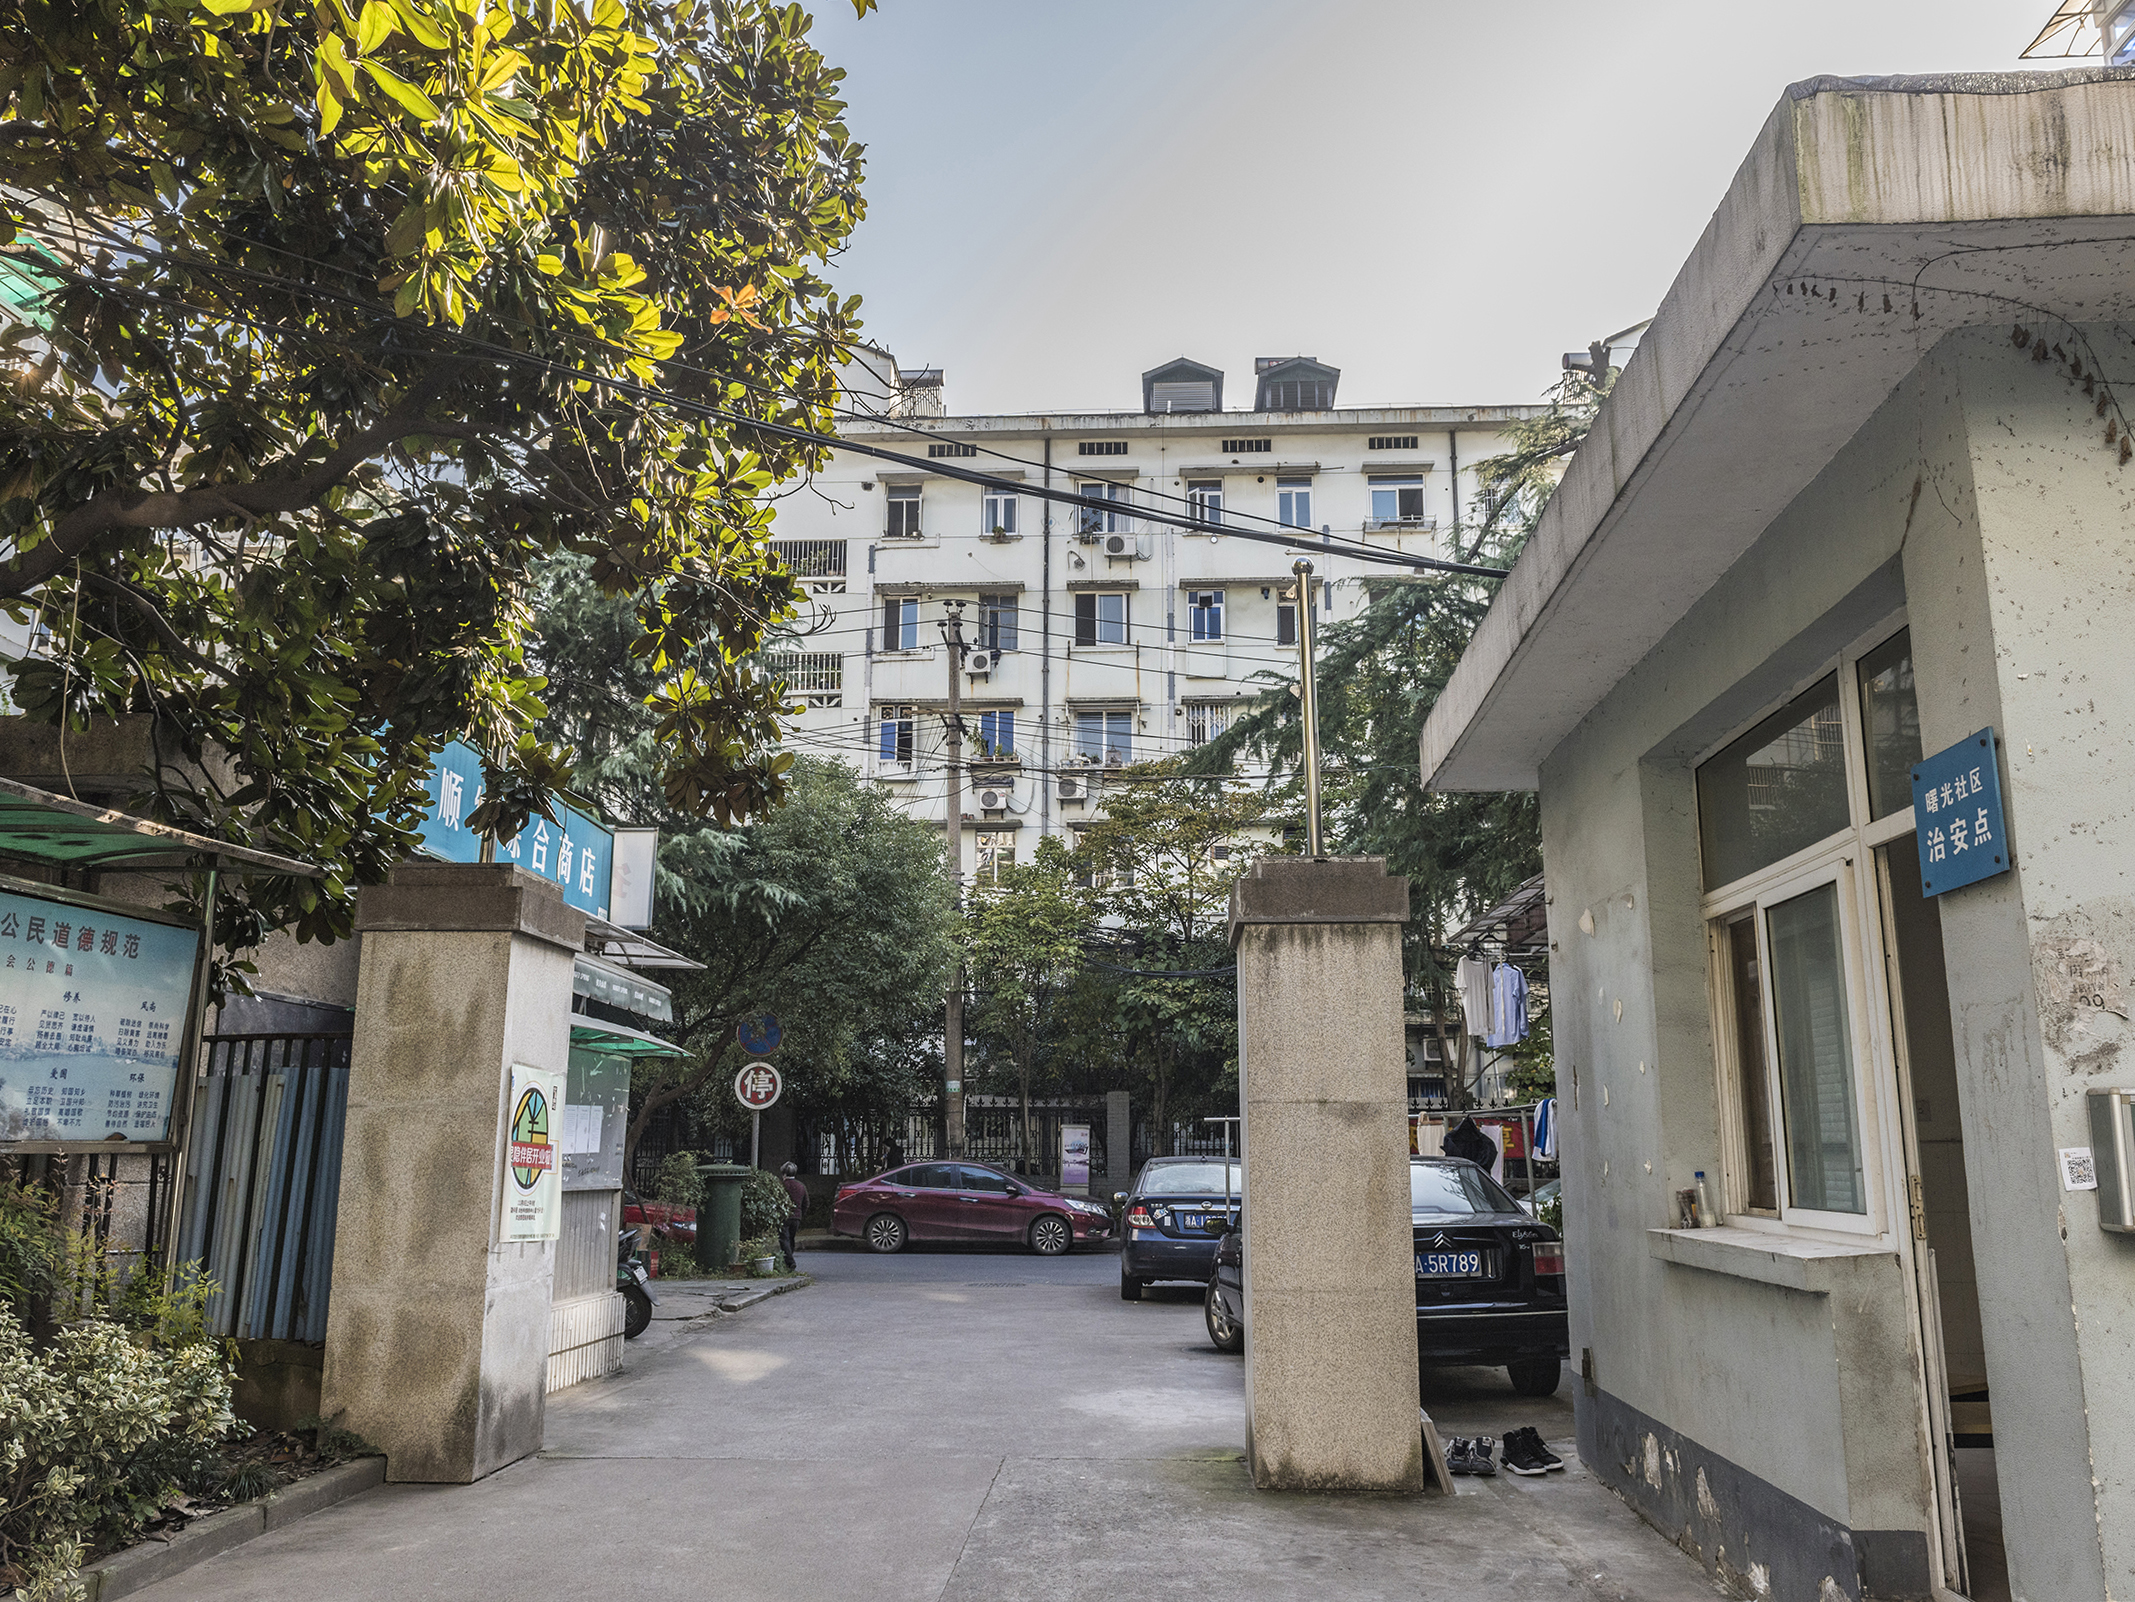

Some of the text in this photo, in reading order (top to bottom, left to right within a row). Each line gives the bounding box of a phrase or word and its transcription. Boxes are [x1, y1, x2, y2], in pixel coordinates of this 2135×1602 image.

[1925, 767, 1983, 814] 曙光社区
[1927, 807, 1993, 863] 治安点
[0, 912, 141, 959] 公民道德规范
[744, 1070, 774, 1099] 停
